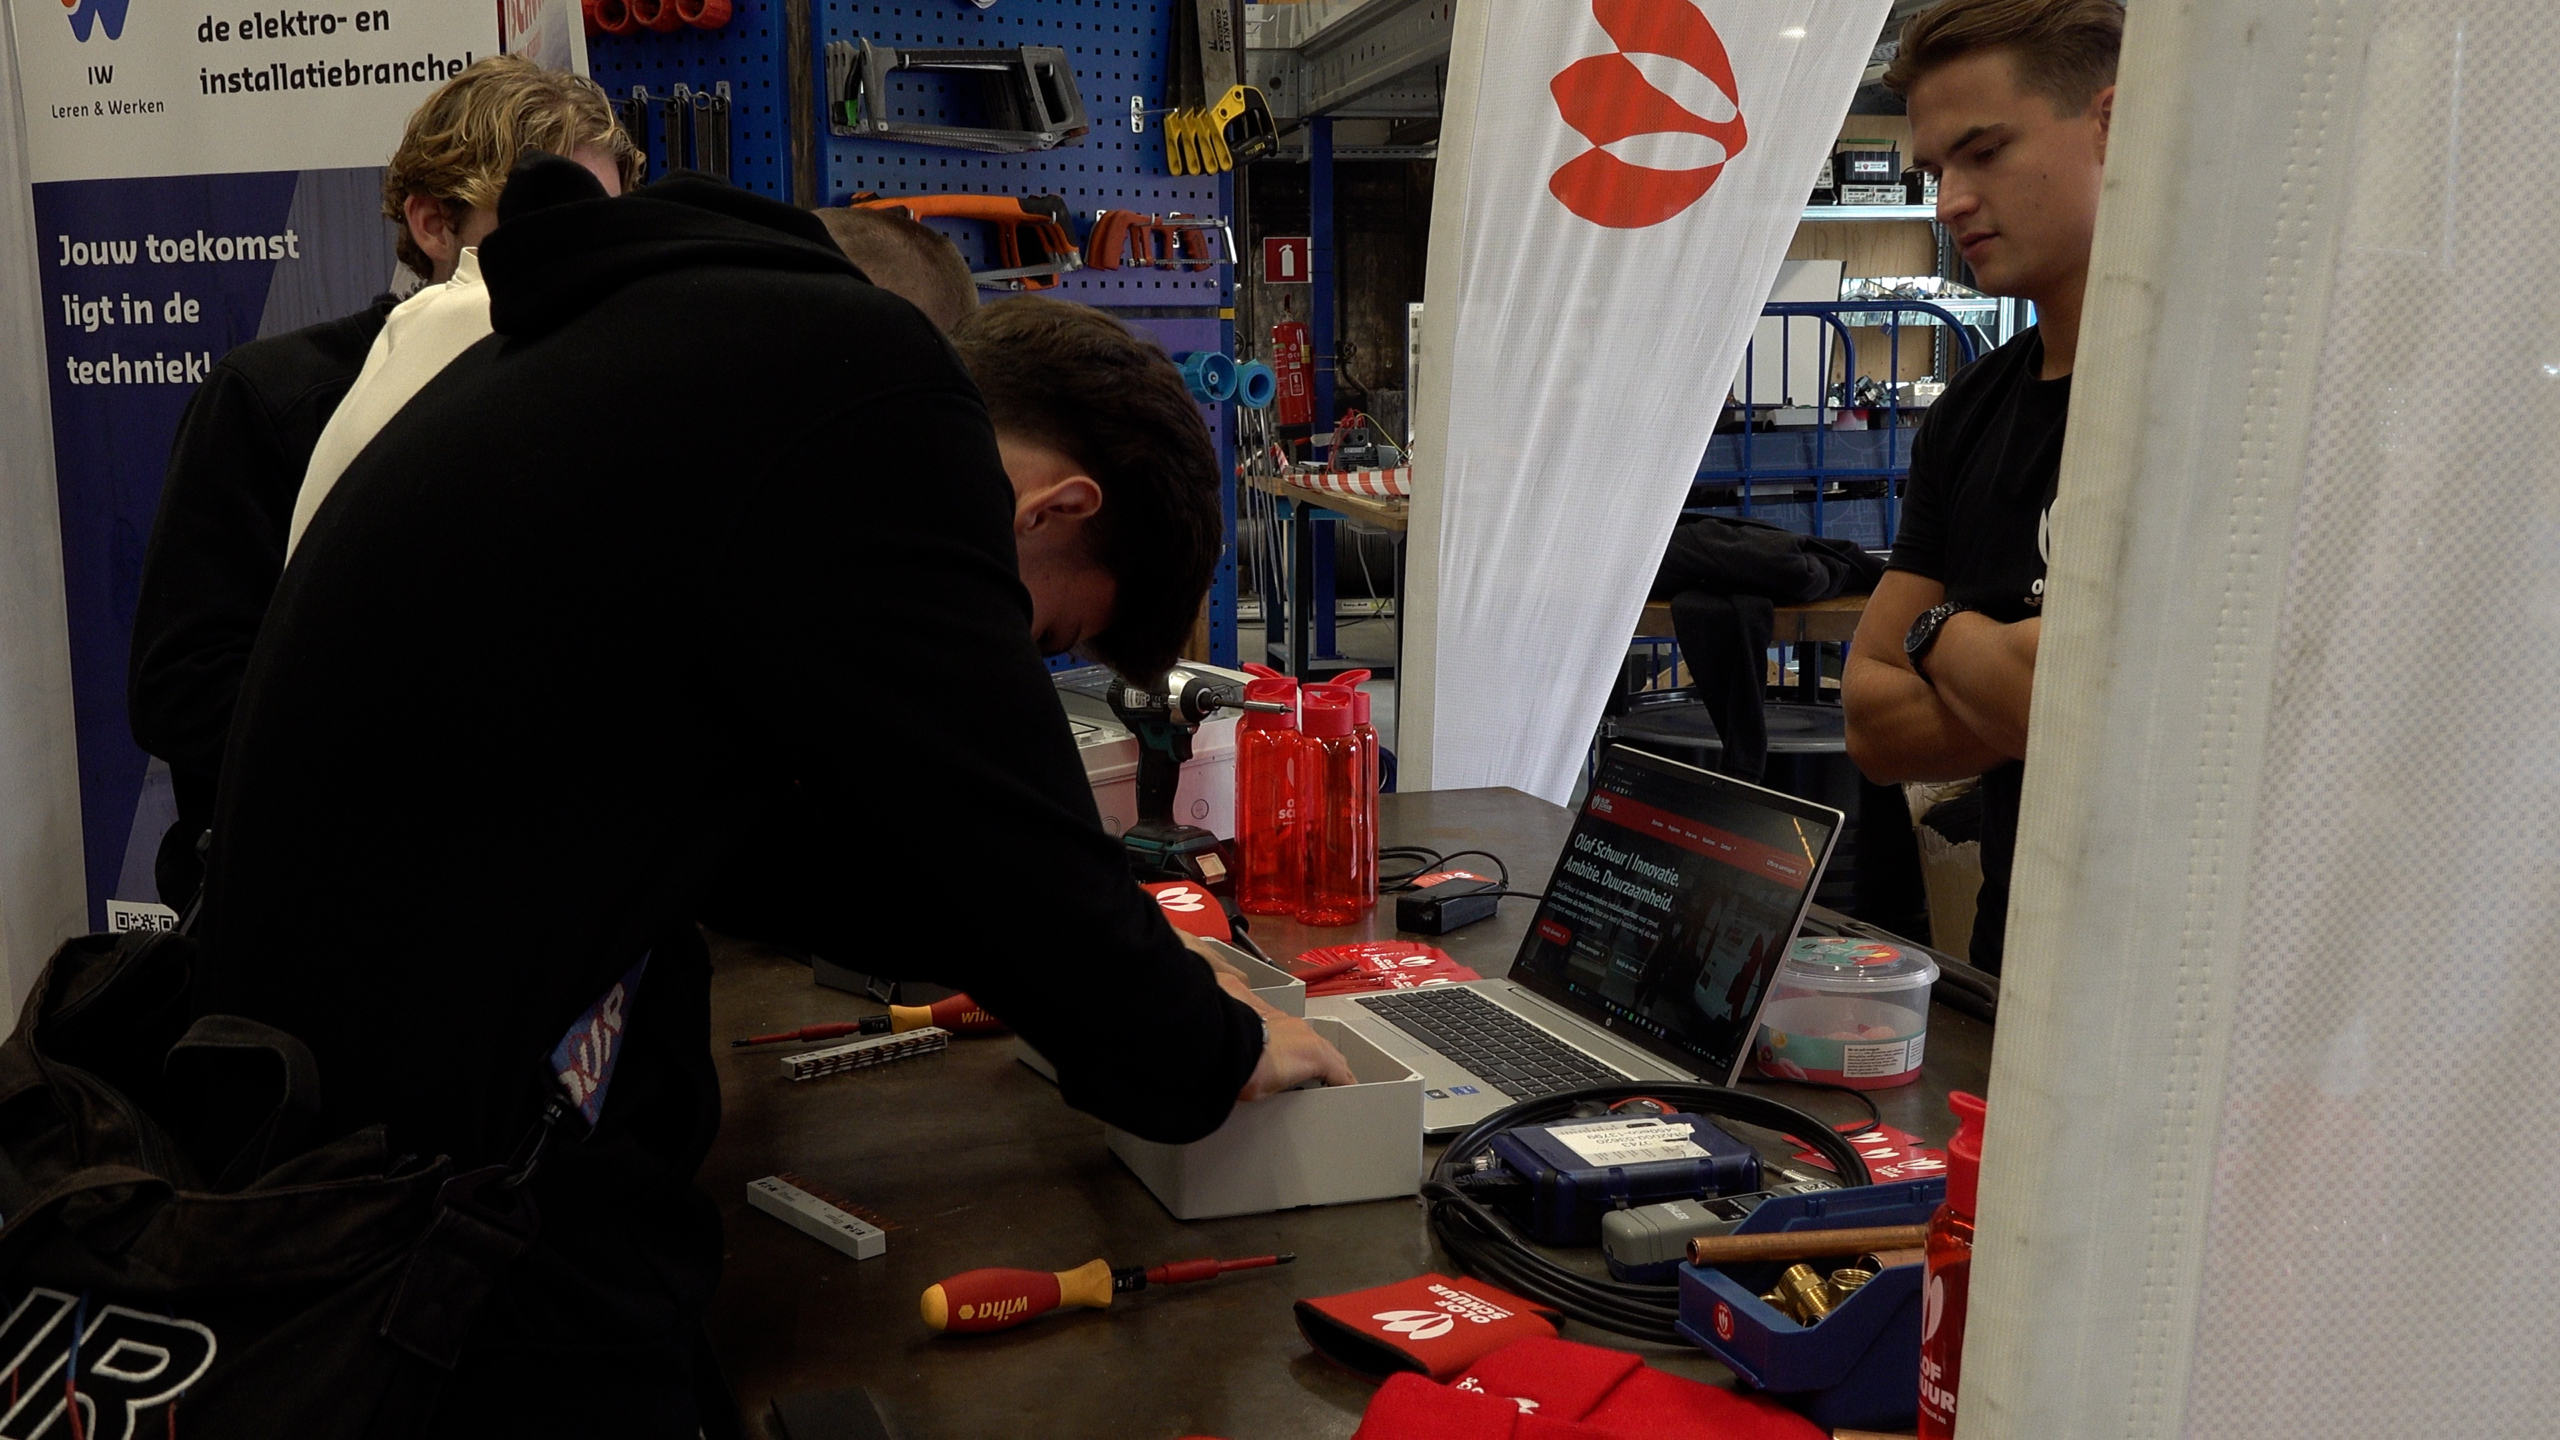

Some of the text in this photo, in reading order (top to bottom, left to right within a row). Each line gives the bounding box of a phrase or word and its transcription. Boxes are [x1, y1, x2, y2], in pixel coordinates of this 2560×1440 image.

[197, 10, 389, 43] de elektro- en
[1222, 9, 1231, 54] STANLEY
[87, 65, 114, 85] IW
[51, 99, 165, 119] Leren & Werken
[59, 229, 300, 267] Jouw toekomst
[62, 291, 200, 333] ligt in de
[66, 351, 211, 385] techniek!
[1574, 833, 1596, 852] Olof
[1594, 841, 1626, 864] Schuur
[1632, 855, 1678, 885] Innovatie.
[1564, 856, 1671, 910] Ambitie. Duurzaamheid.
[979, 1295, 1028, 1322] wiha
[1427, 1283, 1509, 1320] SCHUUR
[1433, 1299, 1491, 1324] OLOF
